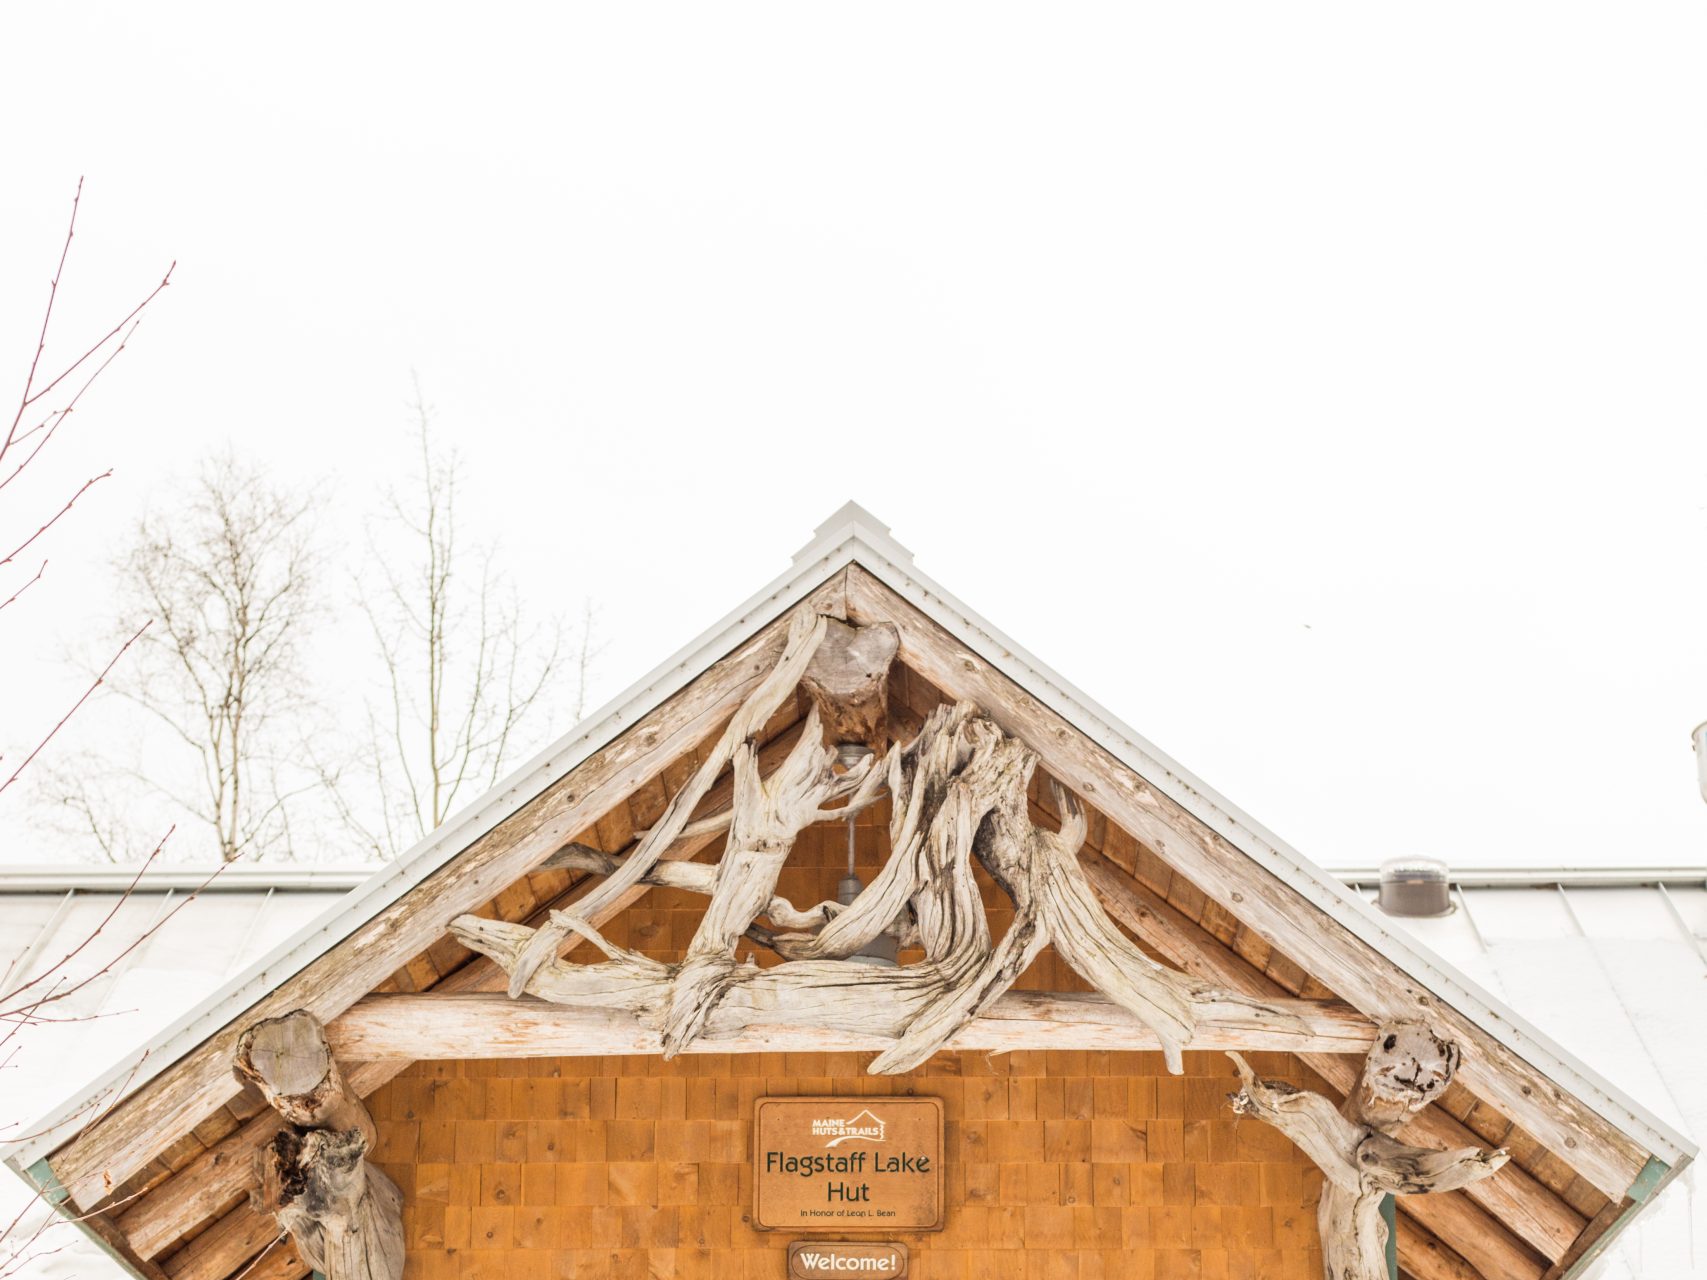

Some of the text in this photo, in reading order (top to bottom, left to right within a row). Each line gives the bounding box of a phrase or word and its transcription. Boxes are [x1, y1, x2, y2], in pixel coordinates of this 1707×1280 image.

[812, 1119, 846, 1127] MAINE
[767, 1151, 931, 1177] Flagstaff Lake
[827, 1181, 870, 1202] Hut
[800, 1209, 808, 1217] In
[809, 1209, 834, 1217] Honor
[836, 1209, 846, 1217] of
[868, 1209, 875, 1217] L.
[876, 1209, 896, 1217] Bean
[800, 1252, 896, 1271] Welcome!
